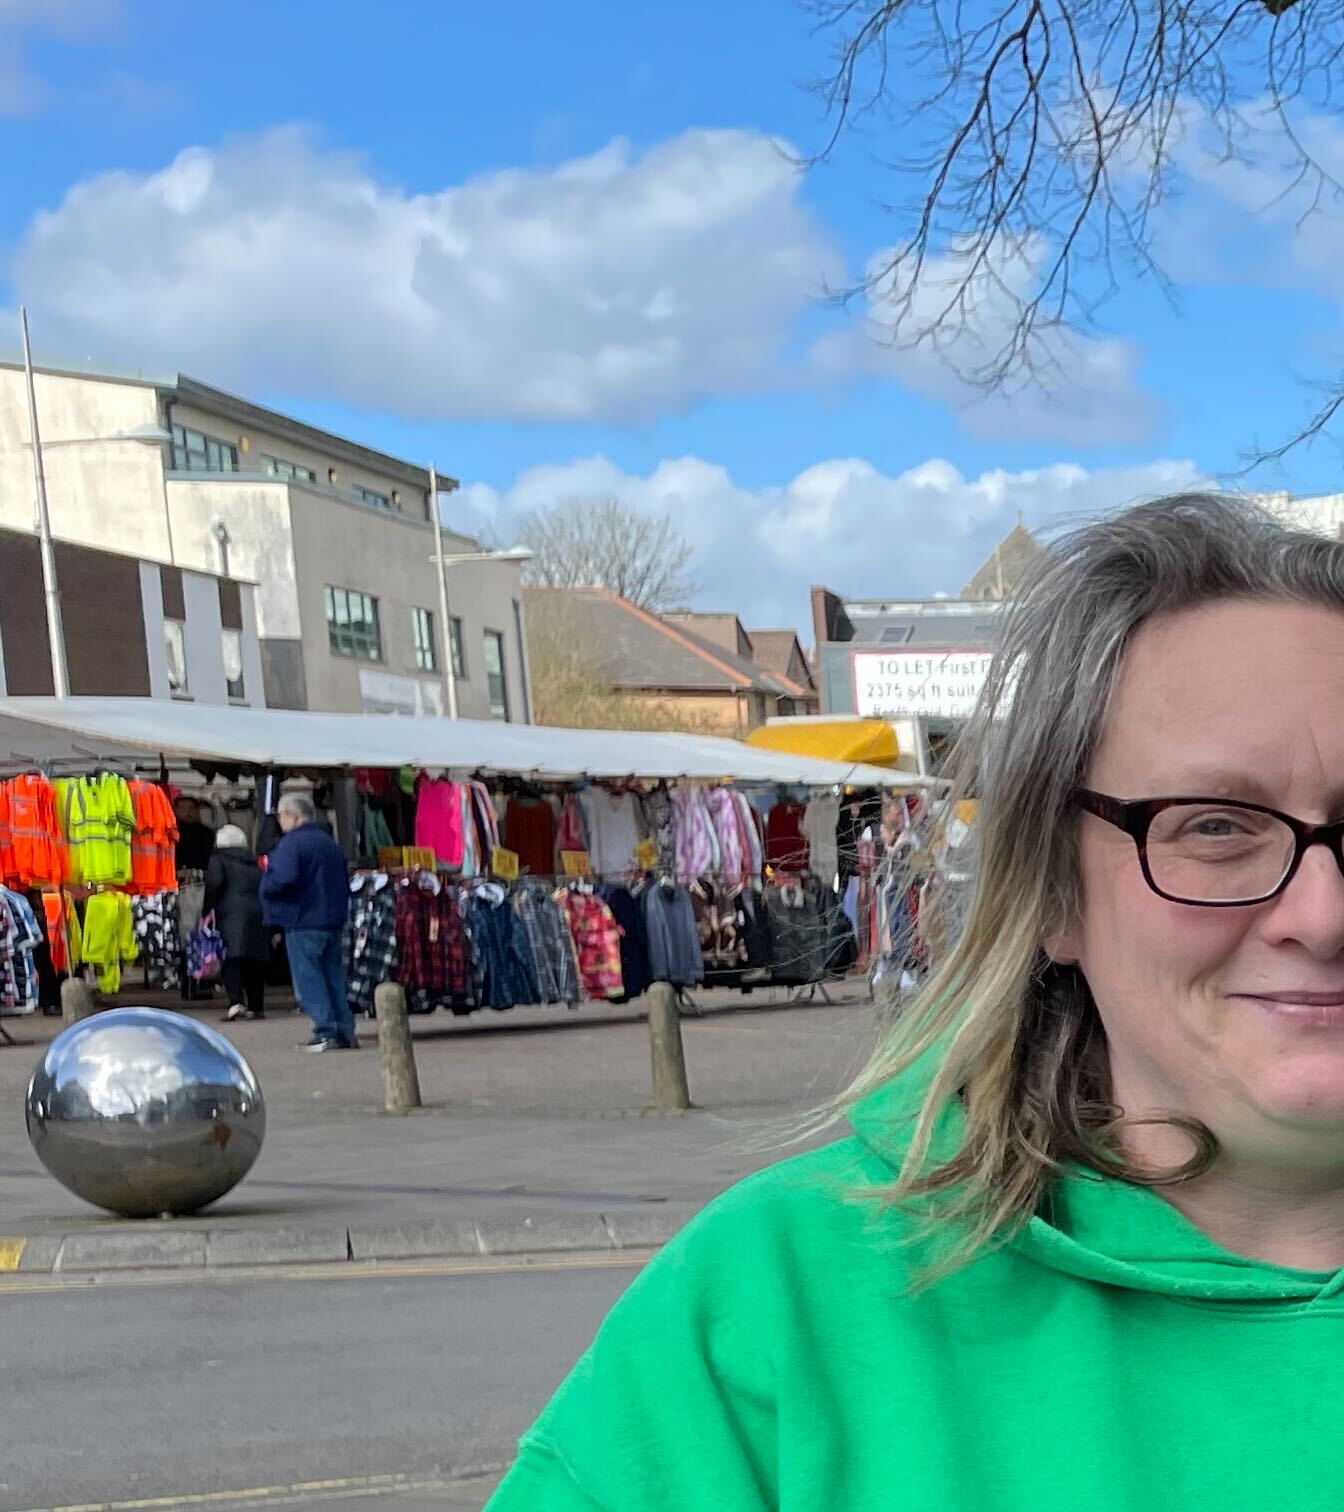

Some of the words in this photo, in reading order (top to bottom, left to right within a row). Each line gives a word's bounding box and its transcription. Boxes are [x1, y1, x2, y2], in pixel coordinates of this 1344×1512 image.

[878, 660, 899, 675] TO
[904, 659, 935, 676] LET
[947, 682, 978, 698] suit
